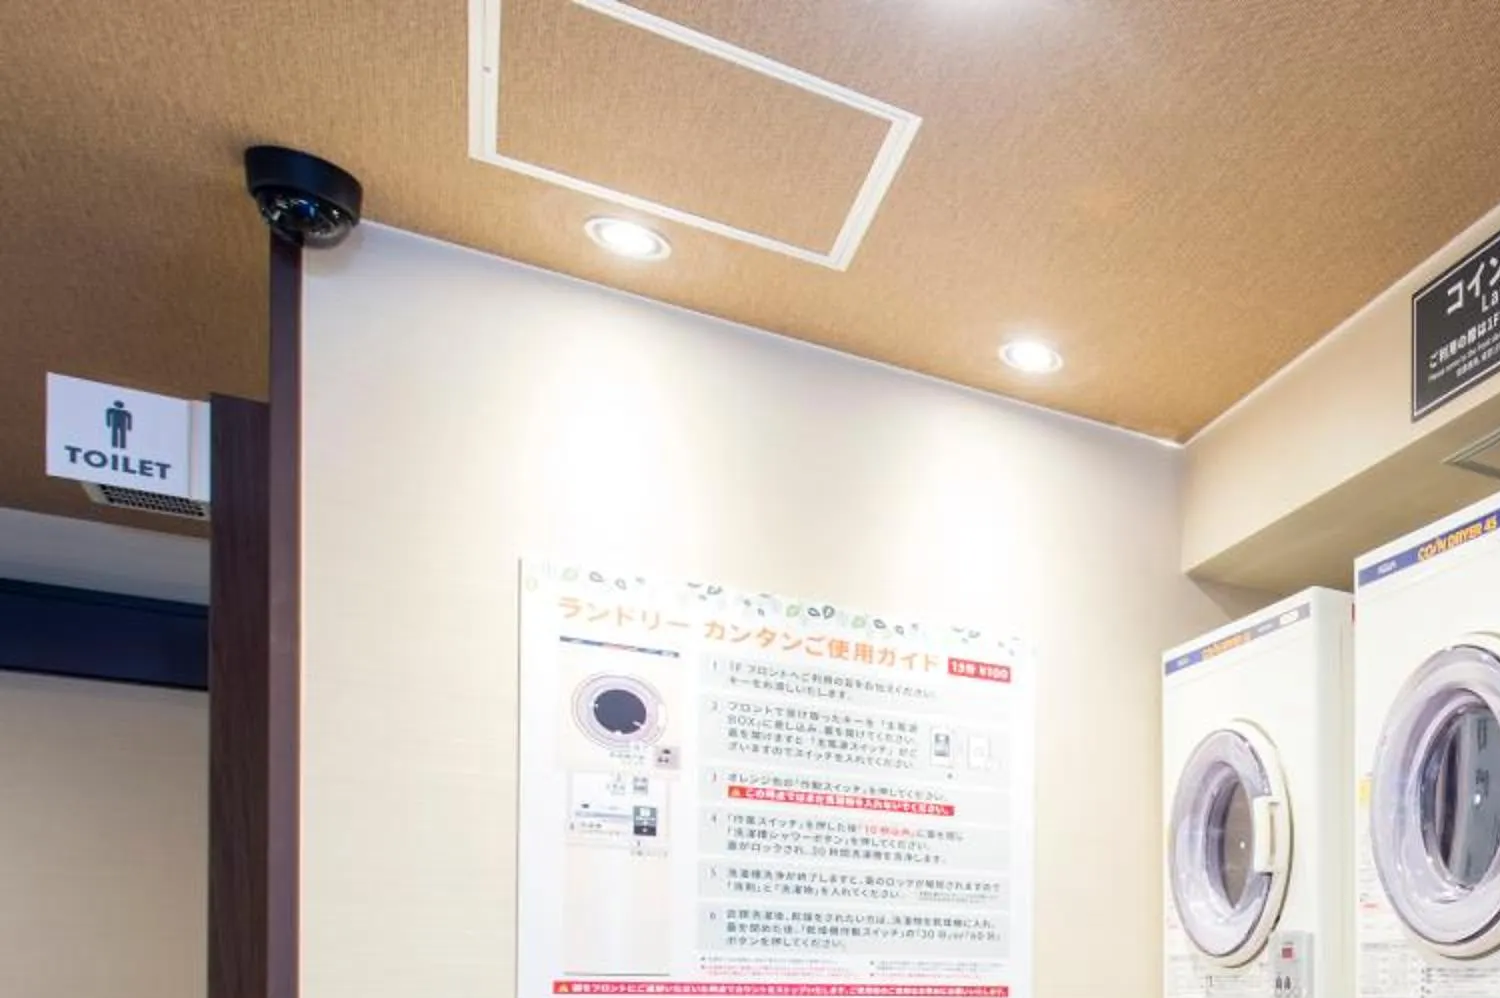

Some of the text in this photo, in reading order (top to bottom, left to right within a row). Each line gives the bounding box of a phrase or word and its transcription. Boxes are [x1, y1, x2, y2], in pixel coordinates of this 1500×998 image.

[64, 445, 171, 480] TOILET
[560, 598, 692, 632] ランドリー
[704, 620, 939, 673] カンタンご使用ガイド
